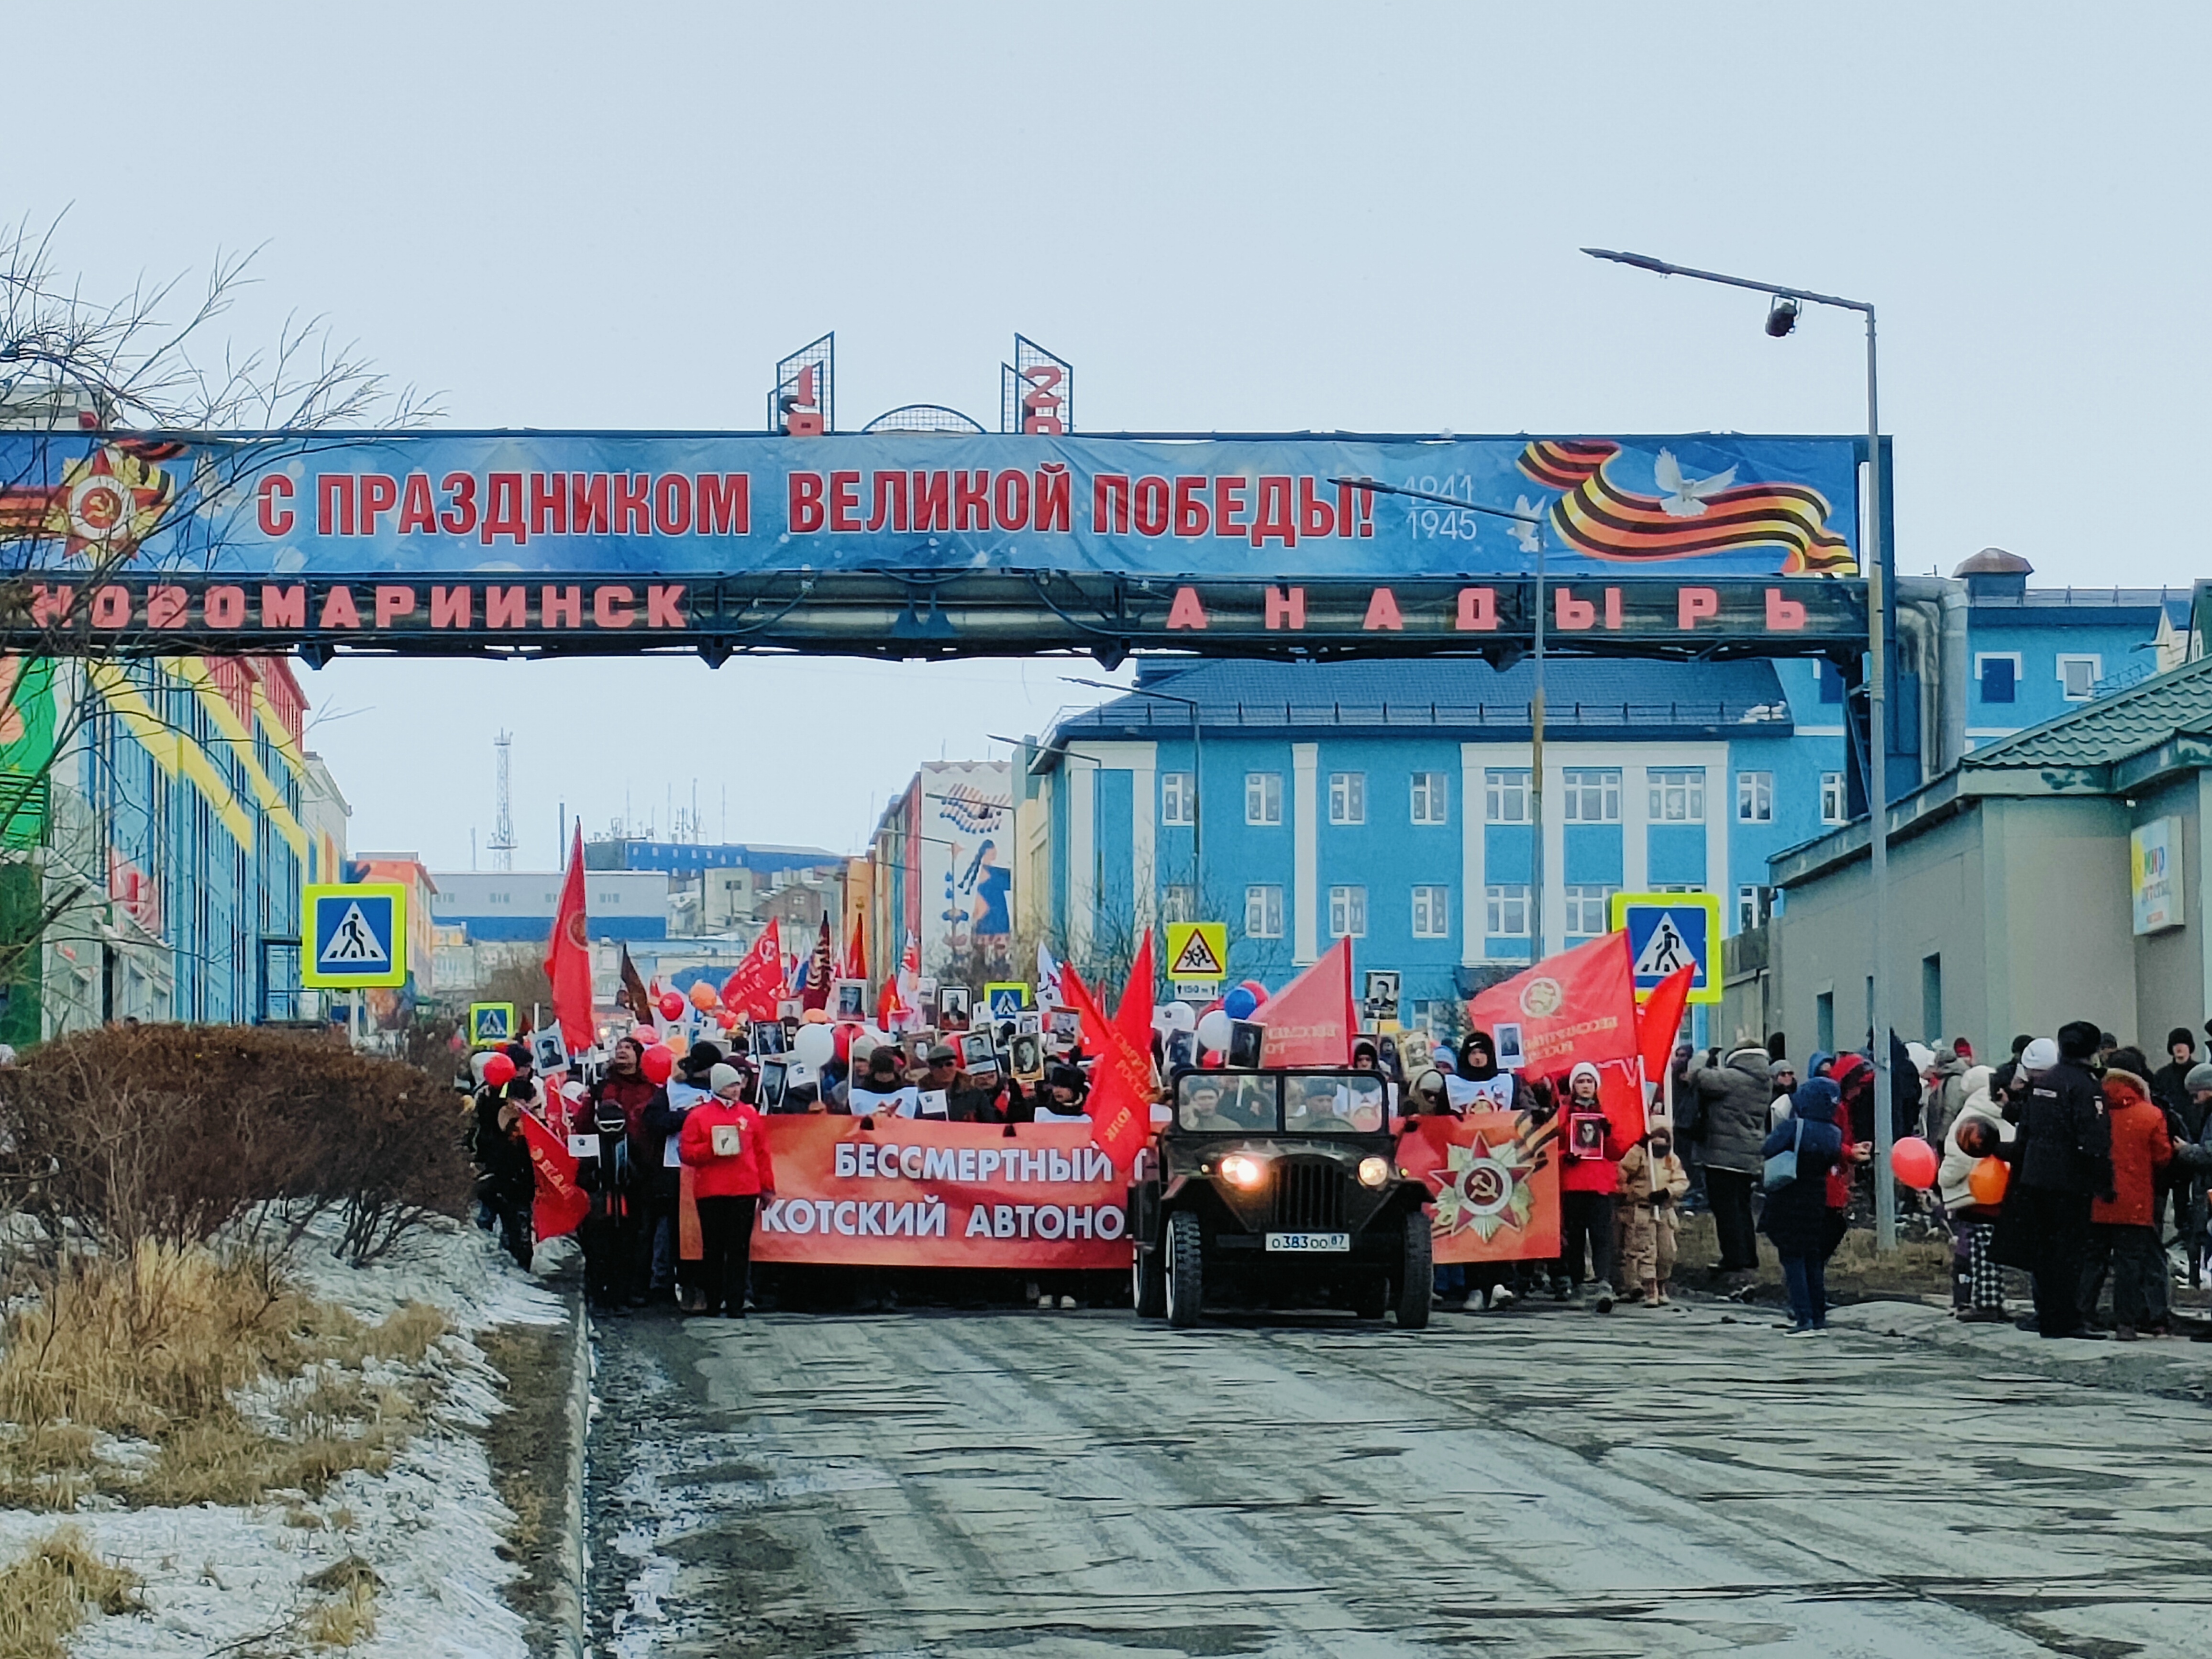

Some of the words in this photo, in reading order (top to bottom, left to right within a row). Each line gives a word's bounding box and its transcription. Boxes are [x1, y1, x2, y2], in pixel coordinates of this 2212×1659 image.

[257, 474, 295, 536] С
[318, 472, 750, 545] ПРАЗДНИКОМ
[788, 462, 1071, 534] ВЕЛИКОЙ
[1093, 475, 1374, 548] ПОБЕДЫ!
[1403, 474, 1473, 505] 1941
[1405, 509, 1477, 541] 1945
[31, 584, 687, 629] НОВОМАРИИНСК
[1166, 586, 1806, 631] АНАДЫРЬ
[1183, 984, 1199, 994] 150
[834, 1140, 1112, 1182] БЕССМЕРТНЫЙ
[756, 1194, 946, 1237] КОТСКИЙ
[965, 1204, 1133, 1240] АВТОНО
[1331, 1234, 1345, 1246] 87
